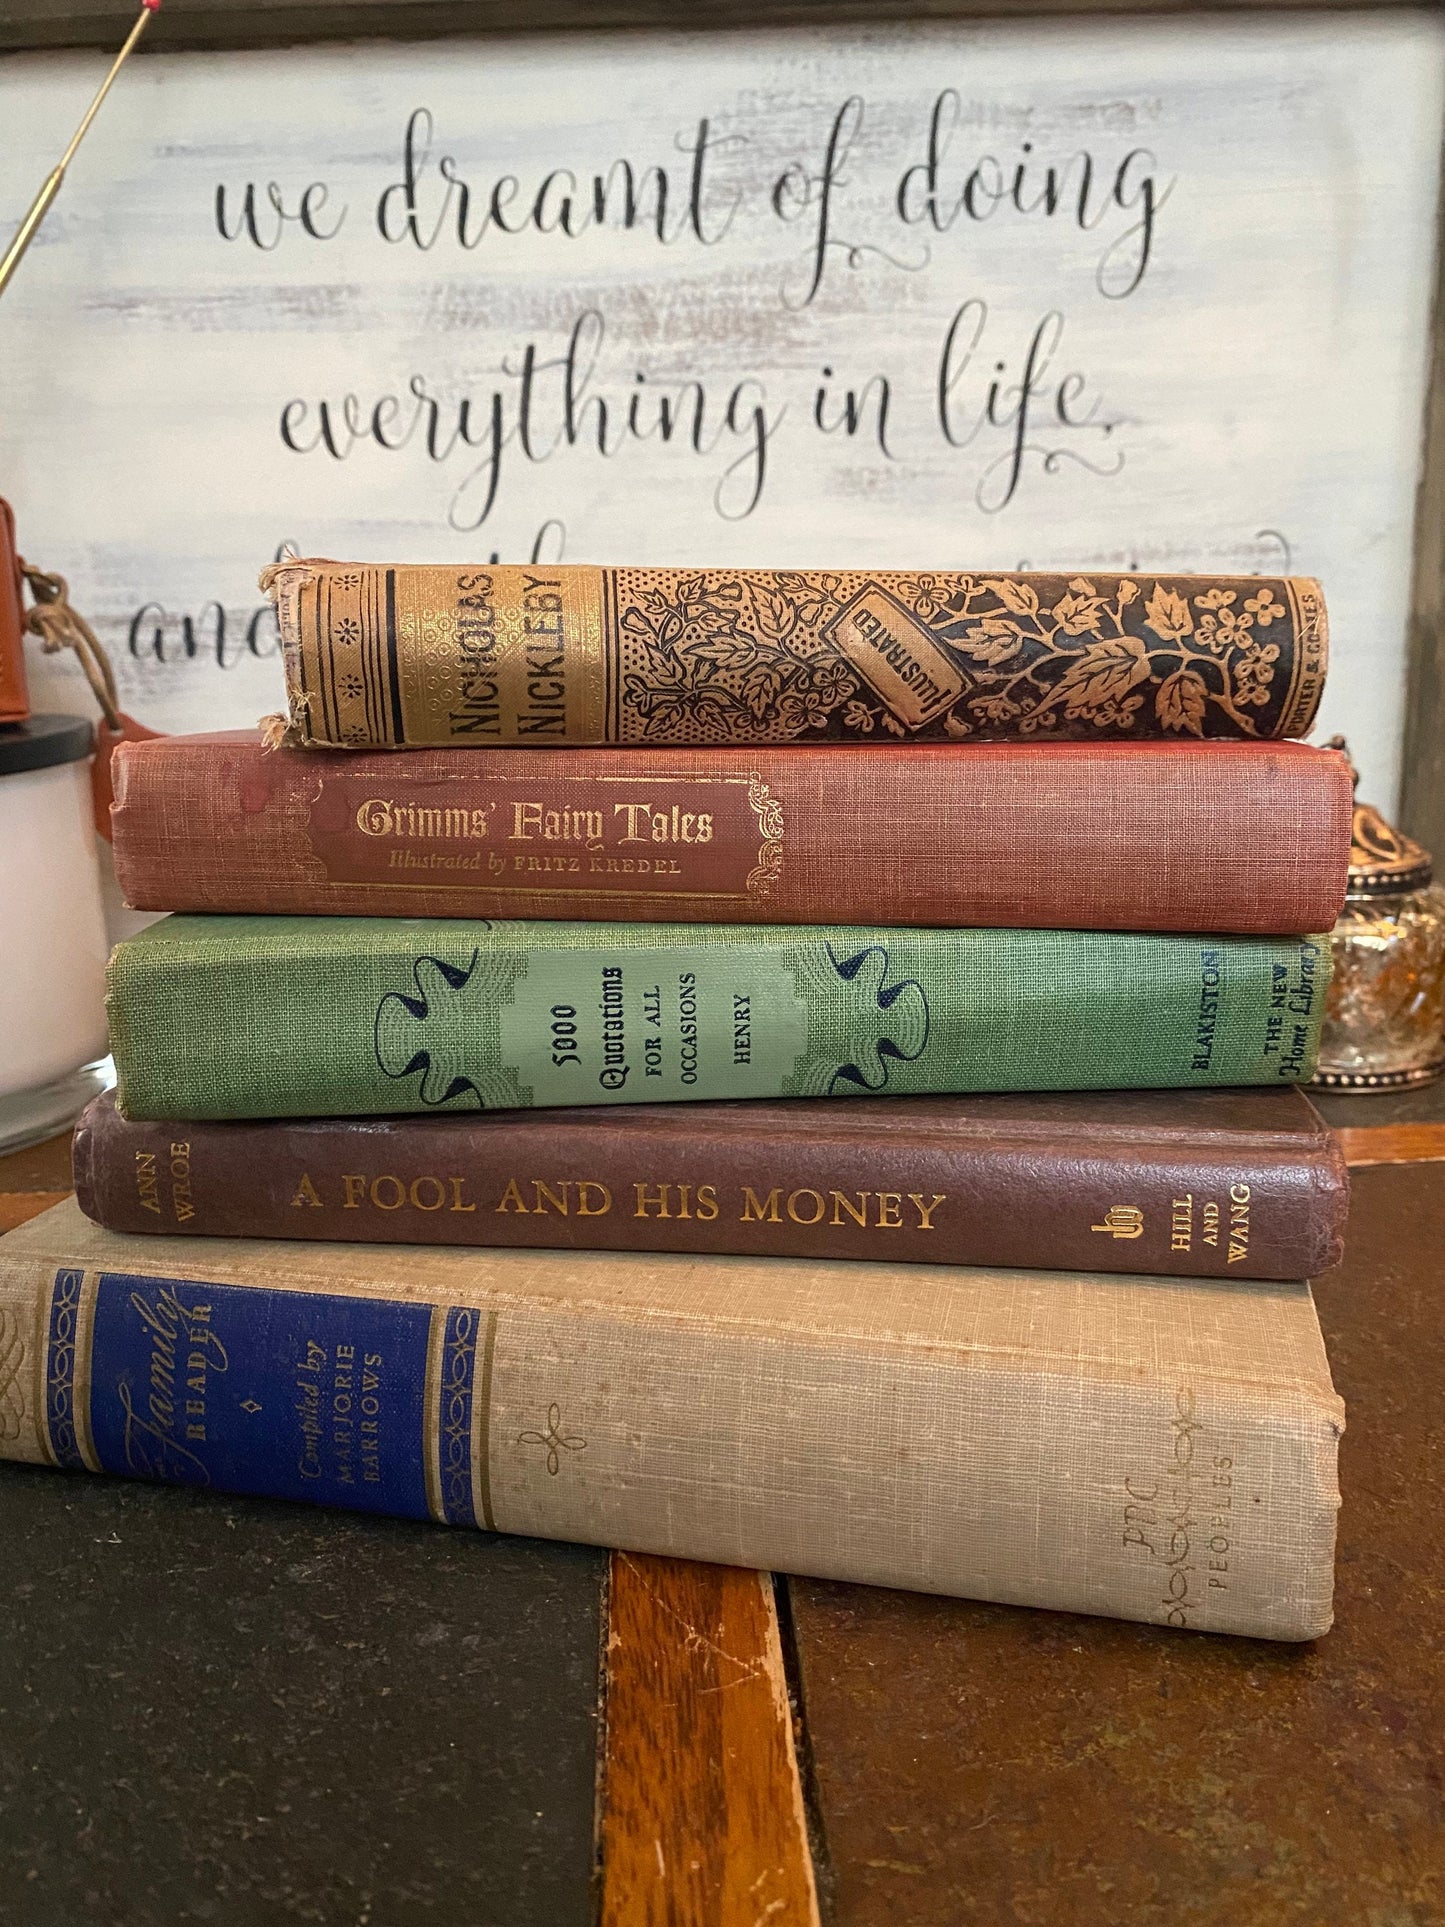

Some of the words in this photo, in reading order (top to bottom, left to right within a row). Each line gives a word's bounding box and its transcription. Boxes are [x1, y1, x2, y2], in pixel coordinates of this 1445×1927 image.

[214, 179, 347, 251] we
[376, 107, 748, 251] dreamt
[772, 95, 931, 310] of
[897, 88, 1177, 299] doing
[280, 309, 788, 531] everything
[814, 365, 897, 460] in
[450, 573, 500, 735] NICHOLAS
[517, 573, 566, 736] NICKLEBY
[852, 608, 952, 714] ILLUSTRATED
[1287, 679, 1316, 733] PORTER
[1306, 659, 1319, 674] &
[388, 848, 482, 870] Illustrated
[488, 850, 507, 875] by
[513, 855, 581, 872] FRITZ
[589, 857, 682, 874] KREDEL
[509, 801, 605, 850] Fairy
[614, 803, 714, 845] Tales
[643, 985, 662, 1027] ALL
[1191, 951, 1220, 1070] BLAKISTON
[1271, 963, 1288, 1008] NEW
[1288, 943, 1321, 1015] Library
[550, 1004, 582, 1067] 5000
[599, 966, 631, 1090] Quotations
[645, 1037, 662, 1077] FOR
[679, 972, 698, 1085] OCCASIONS
[733, 994, 751, 1065] HENRY
[1264, 1017, 1283, 1055] THE
[1278, 1024, 1309, 1077] Home
[135, 1150, 161, 1214] ANN
[170, 1142, 195, 1223] WROE
[290, 1173, 324, 1207] A
[341, 1173, 476, 1212] FOOL
[495, 1178, 611, 1217] AND
[633, 1183, 719, 1221] HIS
[739, 1186, 947, 1230] MONEY
[1171, 1193, 1193, 1252] HILL
[1202, 1201, 1220, 1247] AND
[1227, 1183, 1250, 1265] WANG
[119, 1286, 228, 1486] Family
[185, 1303, 212, 1441] READER
[297, 1340, 327, 1372] by
[295, 1381, 323, 1478] Compiled
[333, 1345, 355, 1484] MARJORIE
[361, 1353, 382, 1482] BARROWS
[1208, 1456, 1233, 1590] PEOPLES
